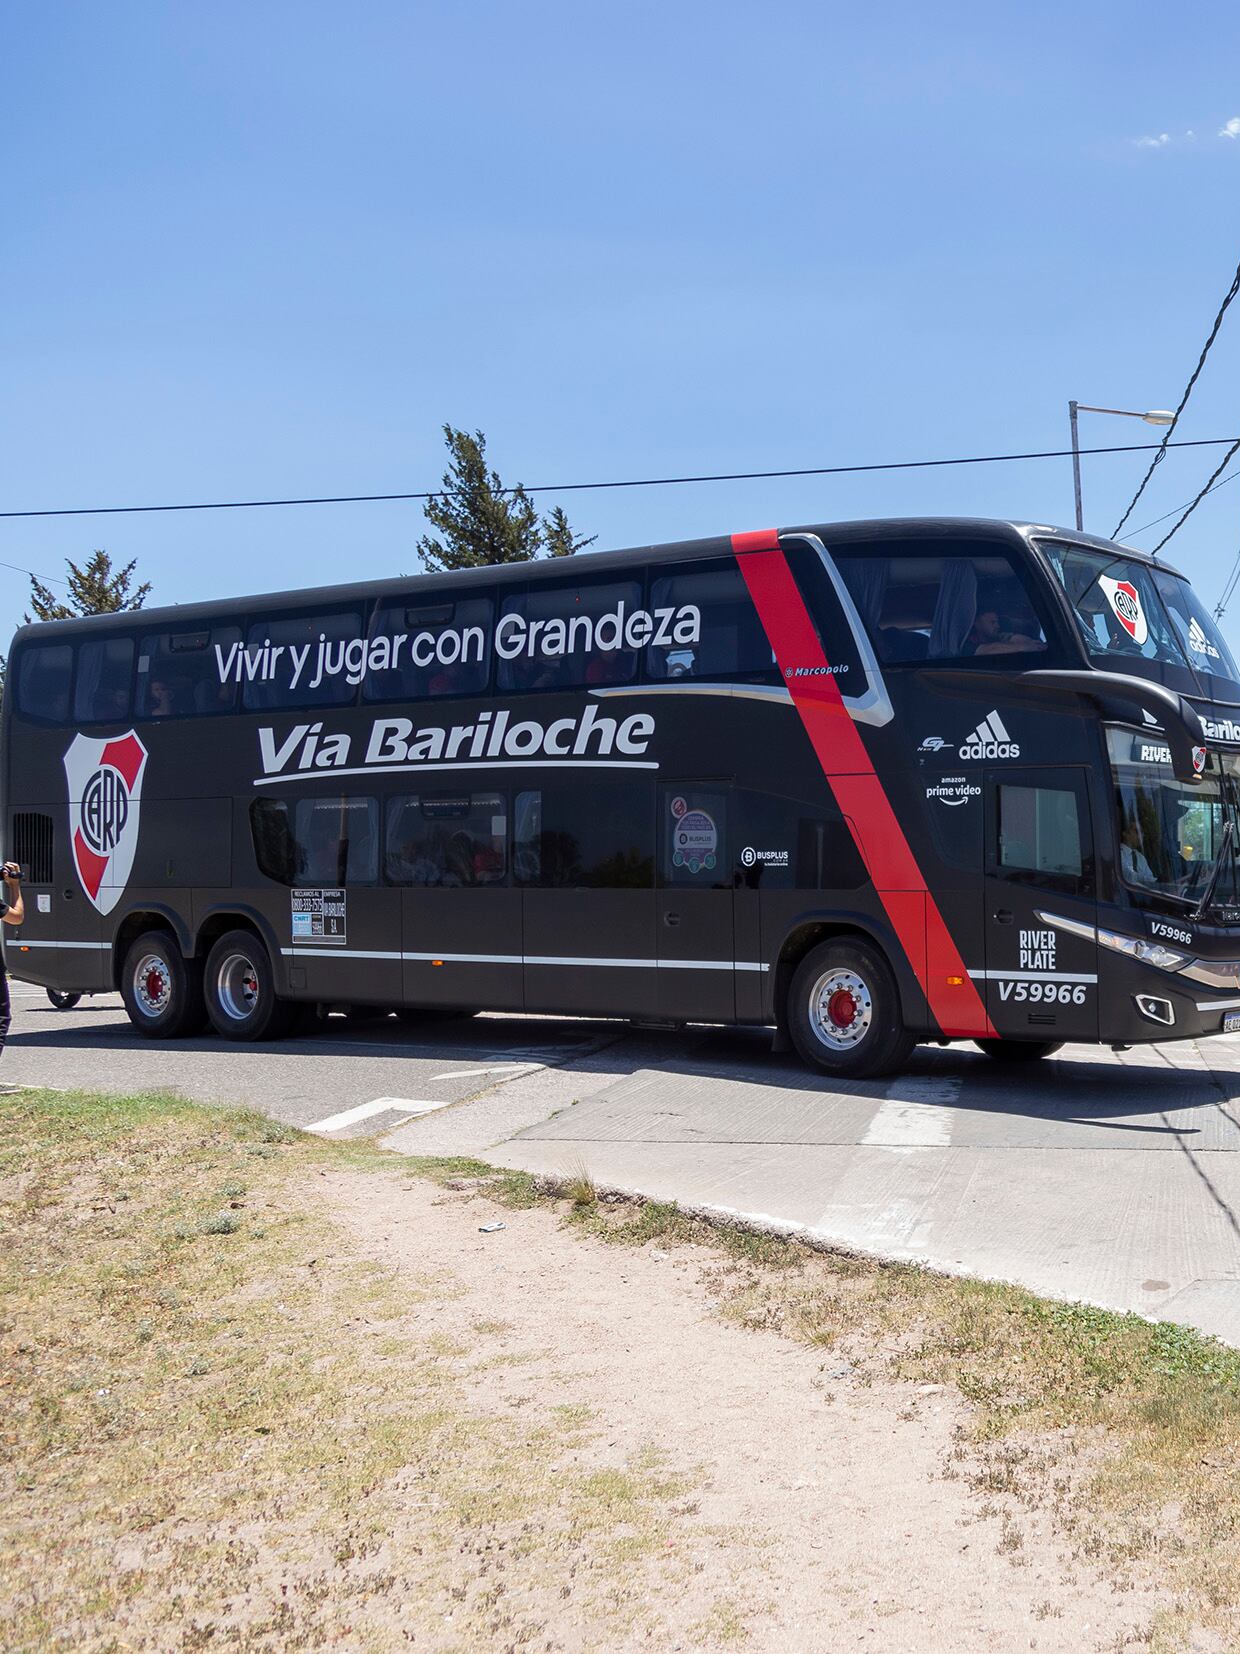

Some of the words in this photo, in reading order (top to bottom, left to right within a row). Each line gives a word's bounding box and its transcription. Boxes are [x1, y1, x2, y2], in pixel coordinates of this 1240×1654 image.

[215, 640, 284, 683] Vivir
[289, 642, 311, 689] y
[309, 632, 407, 689] jugar
[410, 622, 484, 667] con
[494, 600, 701, 660] Grandeza
[1189, 639, 1220, 659] adidas
[794, 663, 849, 676] Marcopolo
[364, 704, 656, 763] Bariloche
[959, 741, 1020, 760] adidas
[926, 786, 953, 798] prime
[954, 785, 981, 796] video
[81, 769, 128, 852] CARP
[757, 851, 788, 859] BUSPLUS
[1020, 930, 1056, 949] RIVER
[1150, 921, 1192, 945] V59966
[1020, 950, 1056, 970] PLATE
[999, 981, 1087, 1005] V59966
